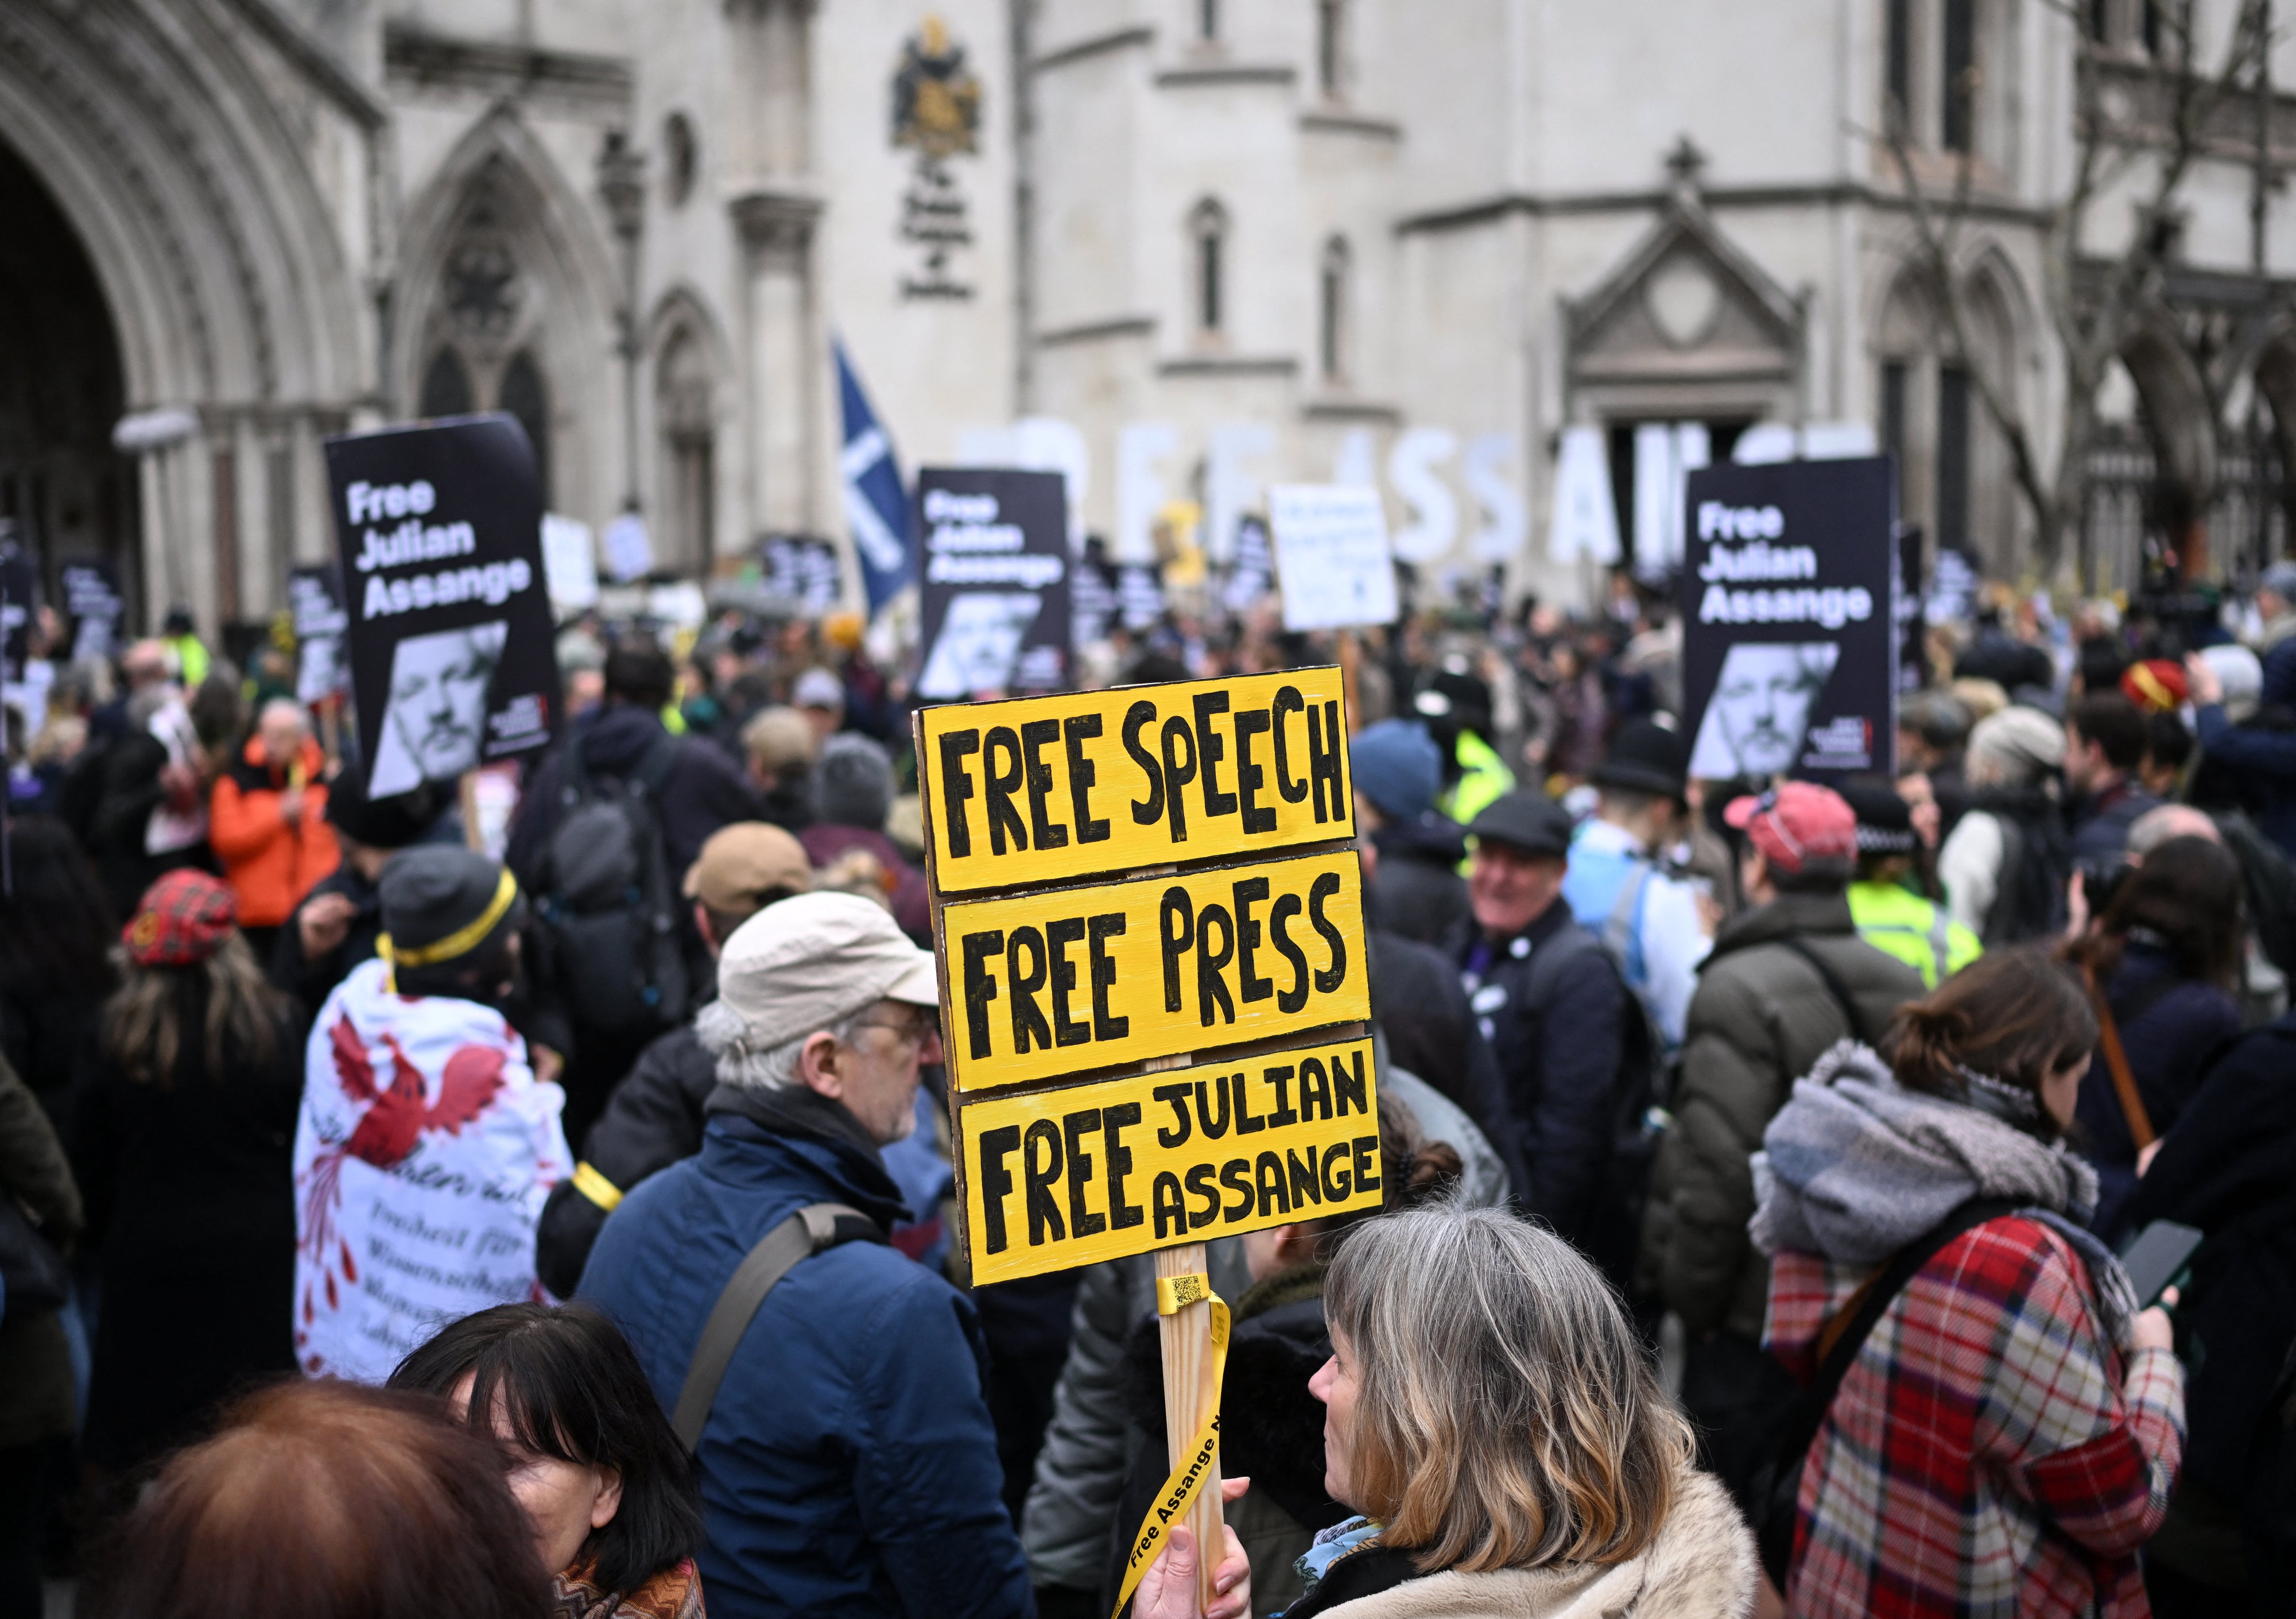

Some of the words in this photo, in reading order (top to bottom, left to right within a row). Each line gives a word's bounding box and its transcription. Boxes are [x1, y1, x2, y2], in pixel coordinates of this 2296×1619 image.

[346, 478, 436, 526] Free
[1697, 501, 1783, 540] Free
[354, 520, 475, 573] Julian
[1698, 541, 1816, 583] Julian
[362, 557, 532, 622] Assange
[1698, 583, 1872, 630] Assange
[938, 714, 1110, 858] FREE
[1122, 685, 1345, 843] SPEECH
[963, 912, 1128, 1060] FREE
[1160, 873, 1347, 1027] PRESS
[979, 1102, 1144, 1255] FREE
[1153, 1051, 1368, 1148] JULIAN
[1153, 1135, 1380, 1240] ASSANGE
[1130, 1524, 1159, 1569] Free
[1157, 1438, 1215, 1525] Assange
